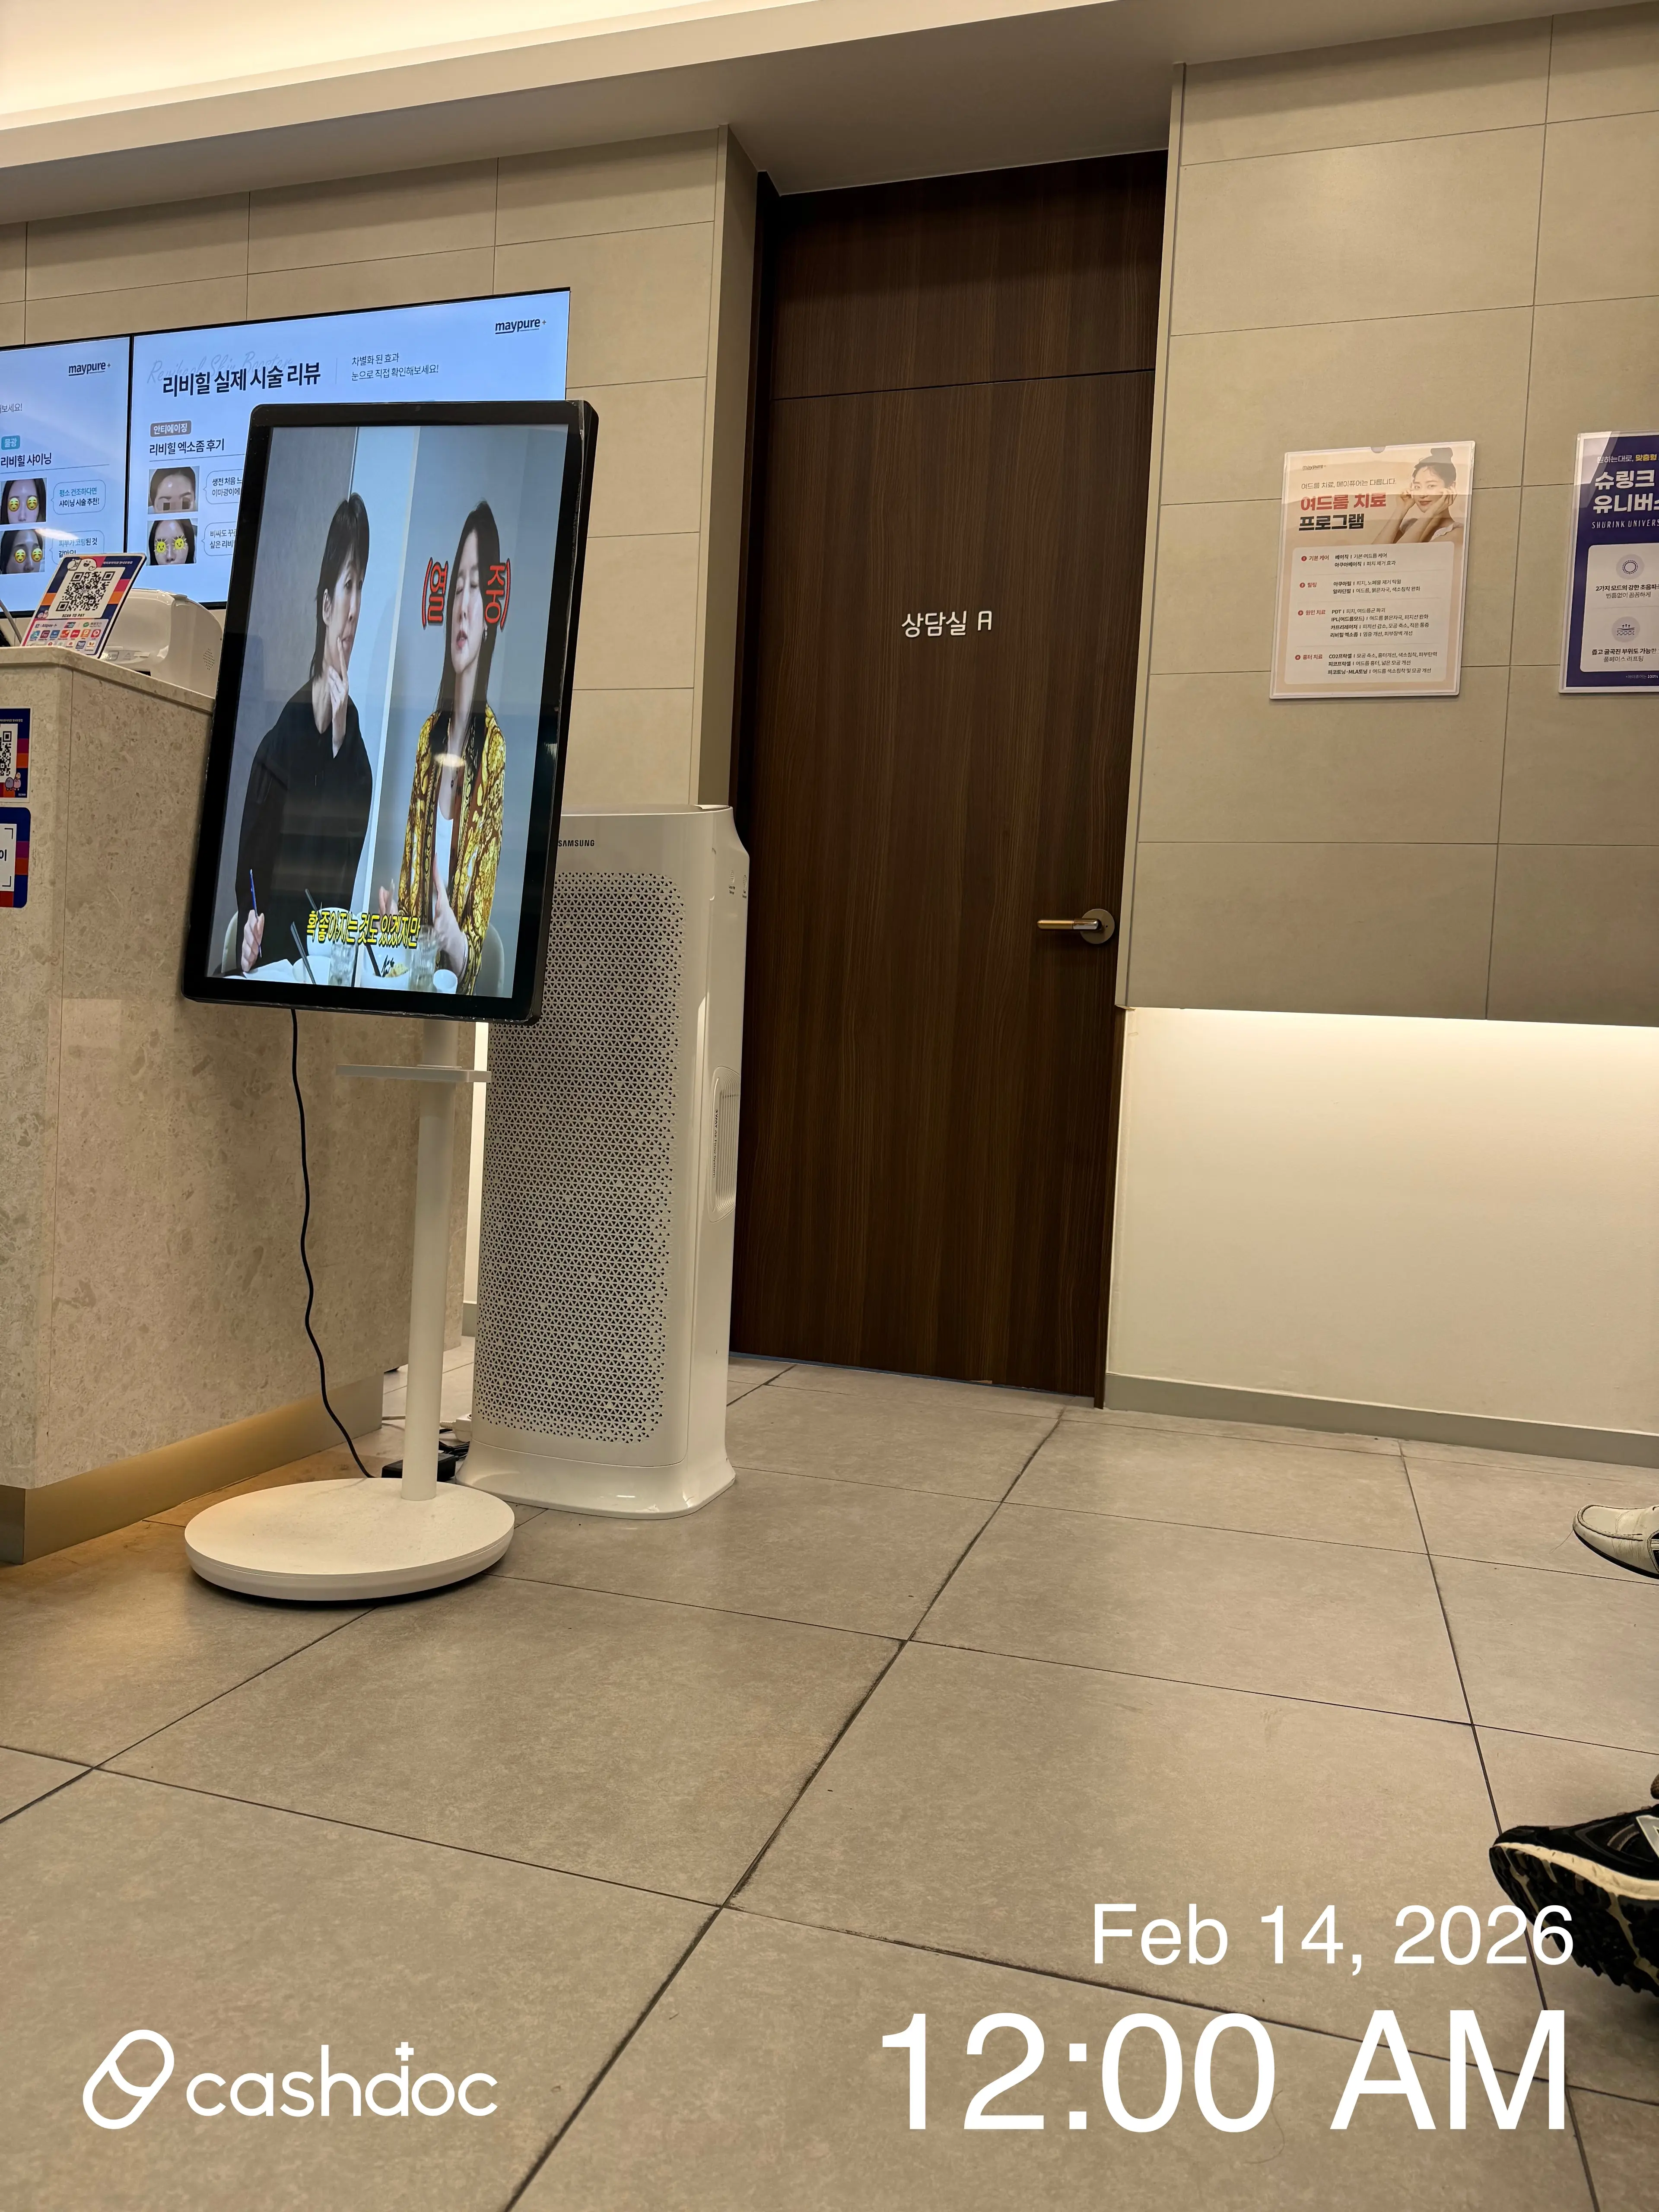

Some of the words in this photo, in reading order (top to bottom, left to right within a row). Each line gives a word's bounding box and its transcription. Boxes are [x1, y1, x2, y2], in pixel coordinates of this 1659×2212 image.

[352, 355, 375, 366] 차별화
[375, 354, 383, 364] 된
[385, 353, 399, 363] 효과
[351, 370, 374, 381] 눈으로
[375, 368, 390, 379] 직접
[391, 364, 439, 378] 확인해보세요!
[162, 372, 210, 397] 리비힐
[214, 368, 247, 394] 실제
[249, 365, 284, 390] 시술
[287, 362, 321, 386] 리뷰
[153, 423, 188, 435] 안티에이징
[4, 438, 17, 448] 물광
[149, 442, 176, 456] 리비힐
[178, 440, 205, 454] 엑소좀
[206, 438, 225, 451] 후기
[0, 454, 25, 468] 리비힐
[27, 452, 52, 466] 샤이닝
[1597, 454, 1634, 464] 원하는대로,
[212, 478, 223, 486] 생전
[224, 477, 236, 486] 처음
[1595, 470, 1655, 490] 슈링크
[59, 489, 70, 498] 평소
[71, 486, 97, 496] 건조하다면
[59, 499, 75, 508] 샤이닝
[76, 498, 86, 507] 시술
[87, 497, 100, 506] 추천!
[1300, 495, 1349, 511] 여드름
[1354, 492, 1386, 509] 치료
[1593, 493, 1659, 514] 유니버
[1299, 513, 1364, 531] 프로그램
[1592, 520, 1625, 529] SHURINK
[210, 529, 227, 537] 비싸도
[75, 538, 91, 547] 코팅된
[92, 537, 98, 545] 것
[210, 540, 222, 549] 싶은
[901, 610, 967, 639] 상담실
[977, 610, 992, 631] A
[306, 910, 318, 943] 확
[318, 910, 359, 945] 좋아지는
[358, 912, 380, 944] 것도
[378, 914, 421, 949] 있겠지만
